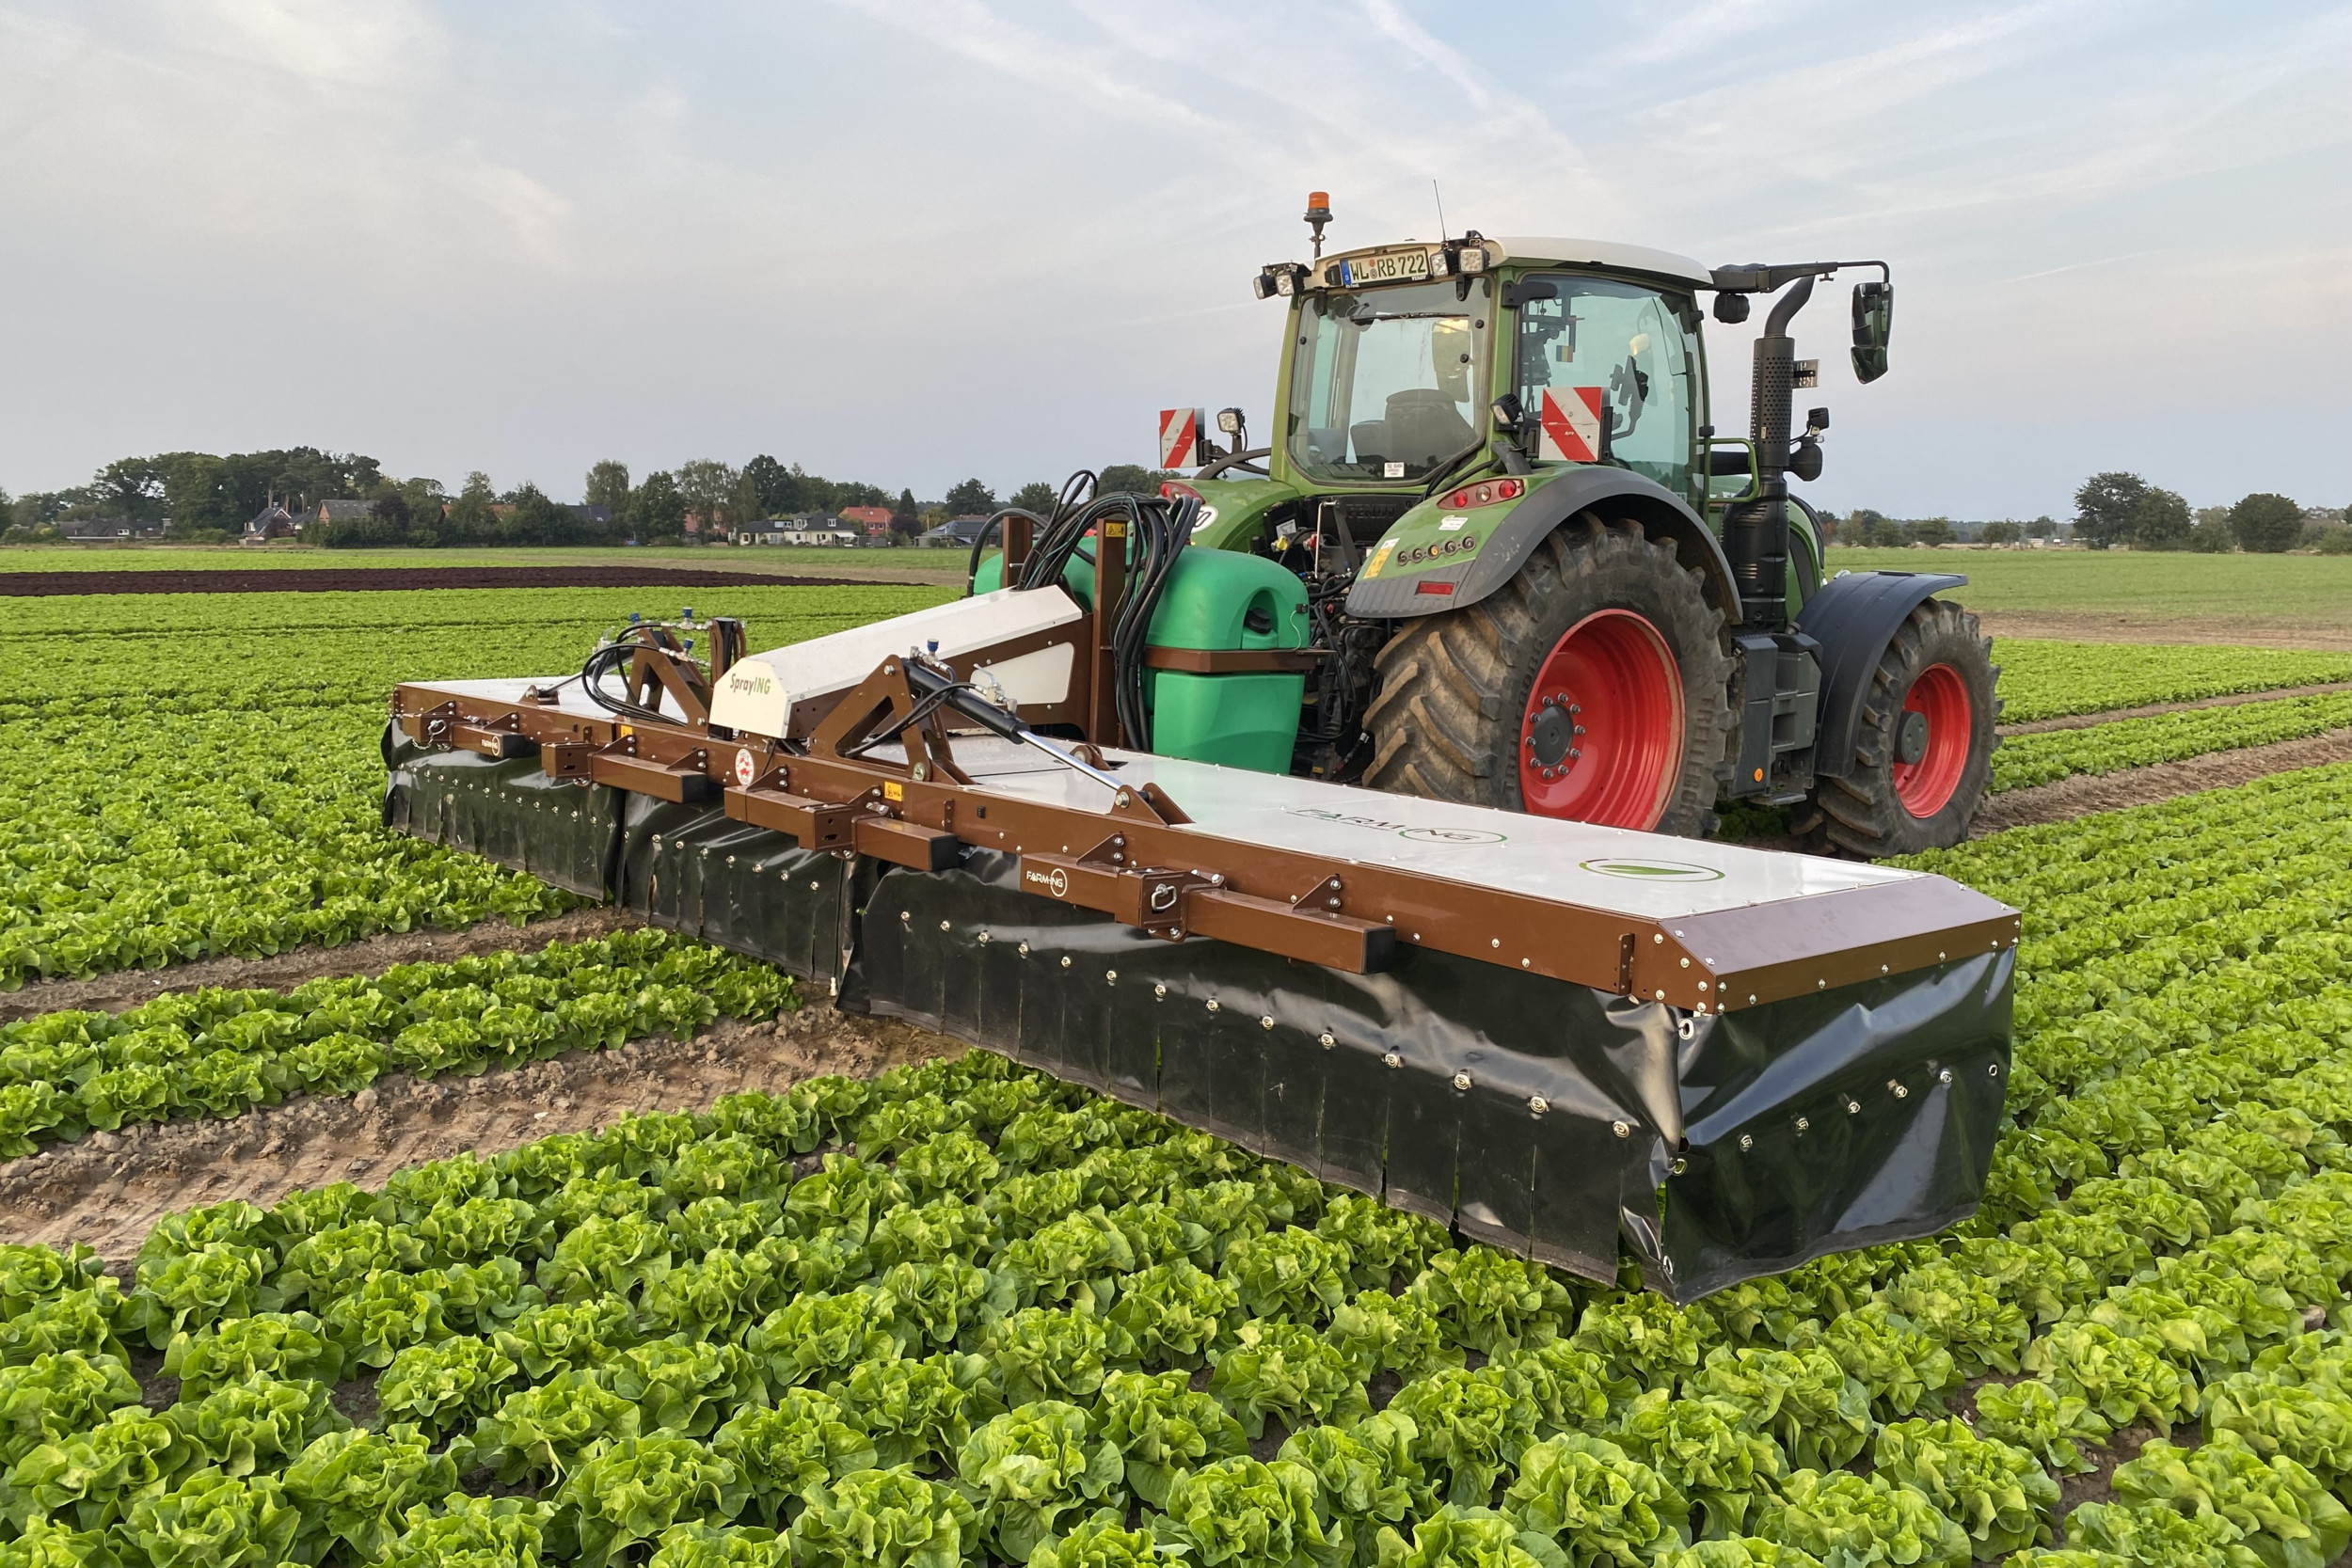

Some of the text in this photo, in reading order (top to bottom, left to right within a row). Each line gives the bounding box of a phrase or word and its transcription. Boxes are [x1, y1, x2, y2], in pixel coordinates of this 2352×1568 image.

[1350, 254, 1425, 280] WL RB 722
[729, 673, 771, 696] SprayING
